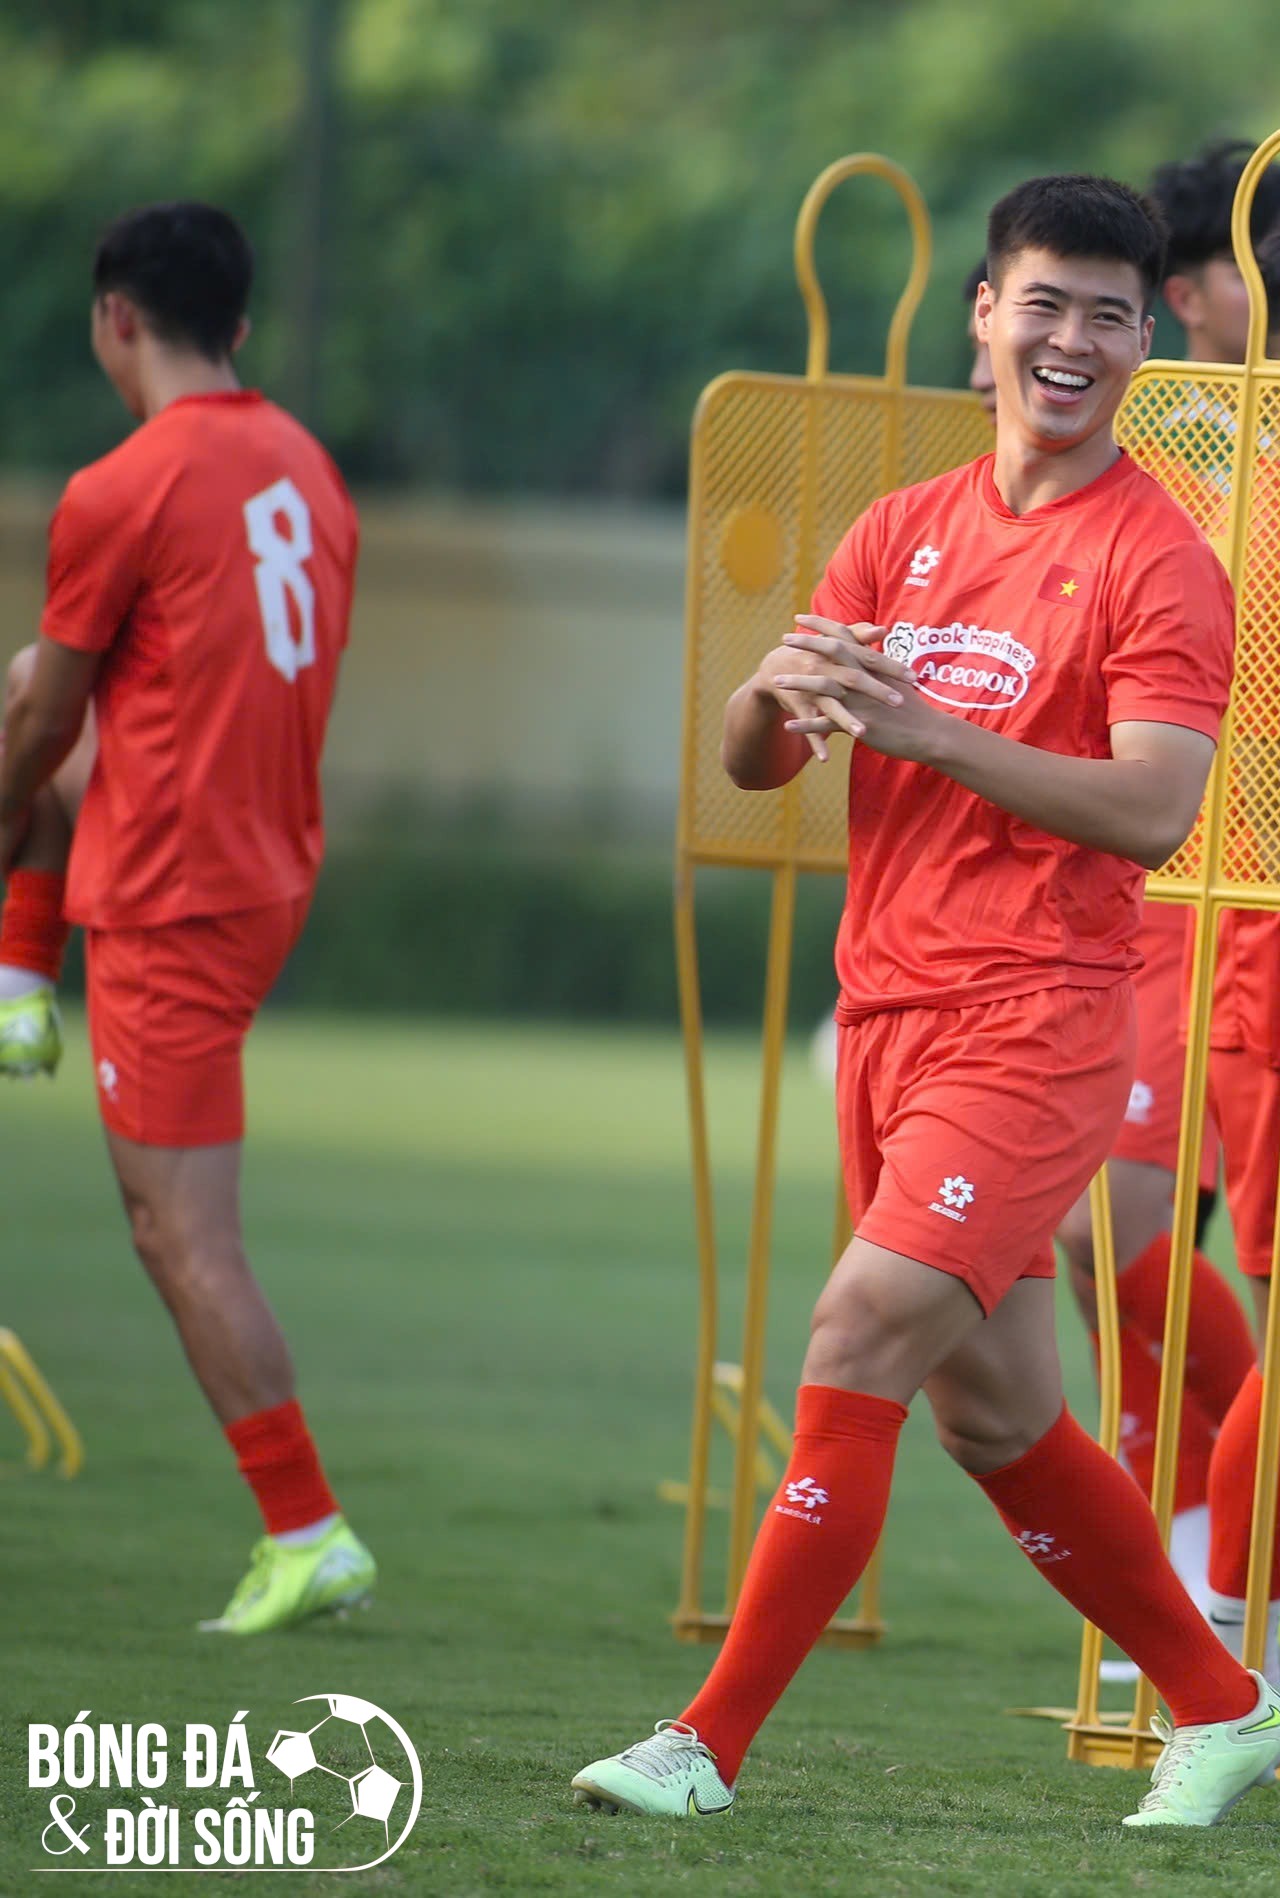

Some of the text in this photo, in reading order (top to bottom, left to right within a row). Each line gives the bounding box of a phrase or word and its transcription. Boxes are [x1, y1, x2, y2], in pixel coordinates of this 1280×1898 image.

[243, 477, 315, 683] 8
[917, 627, 1034, 670] Cook happiness
